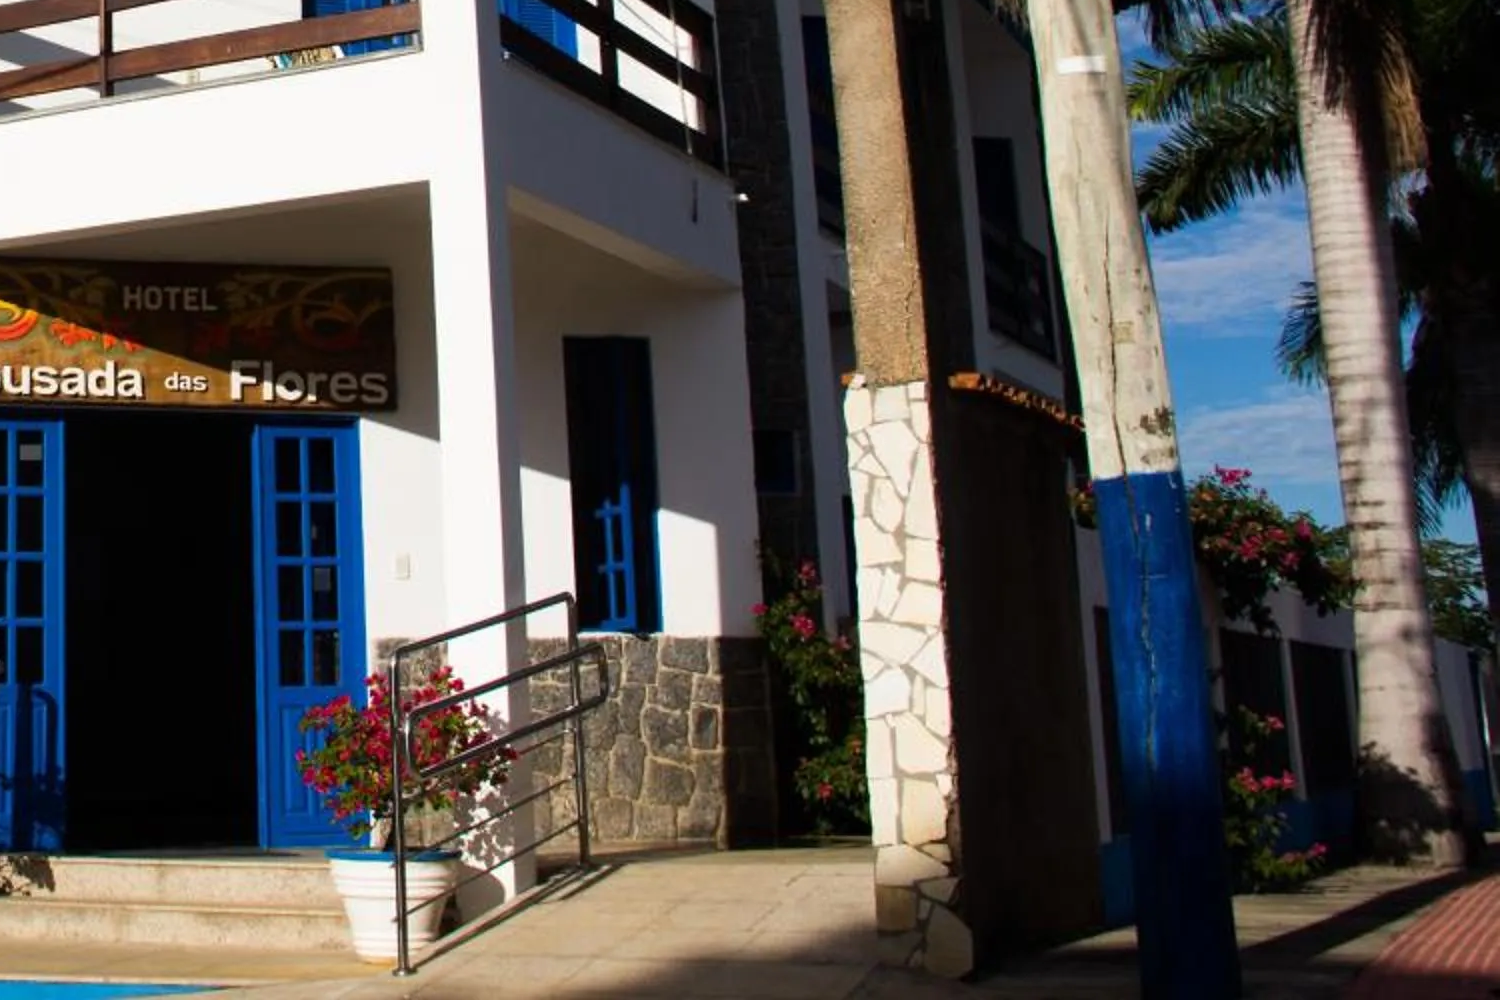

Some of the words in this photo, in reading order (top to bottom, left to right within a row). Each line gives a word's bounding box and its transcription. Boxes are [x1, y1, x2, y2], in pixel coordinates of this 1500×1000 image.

[123, 285, 218, 312] HOTEL
[164, 371, 208, 392] das
[230, 359, 389, 403] Flores
